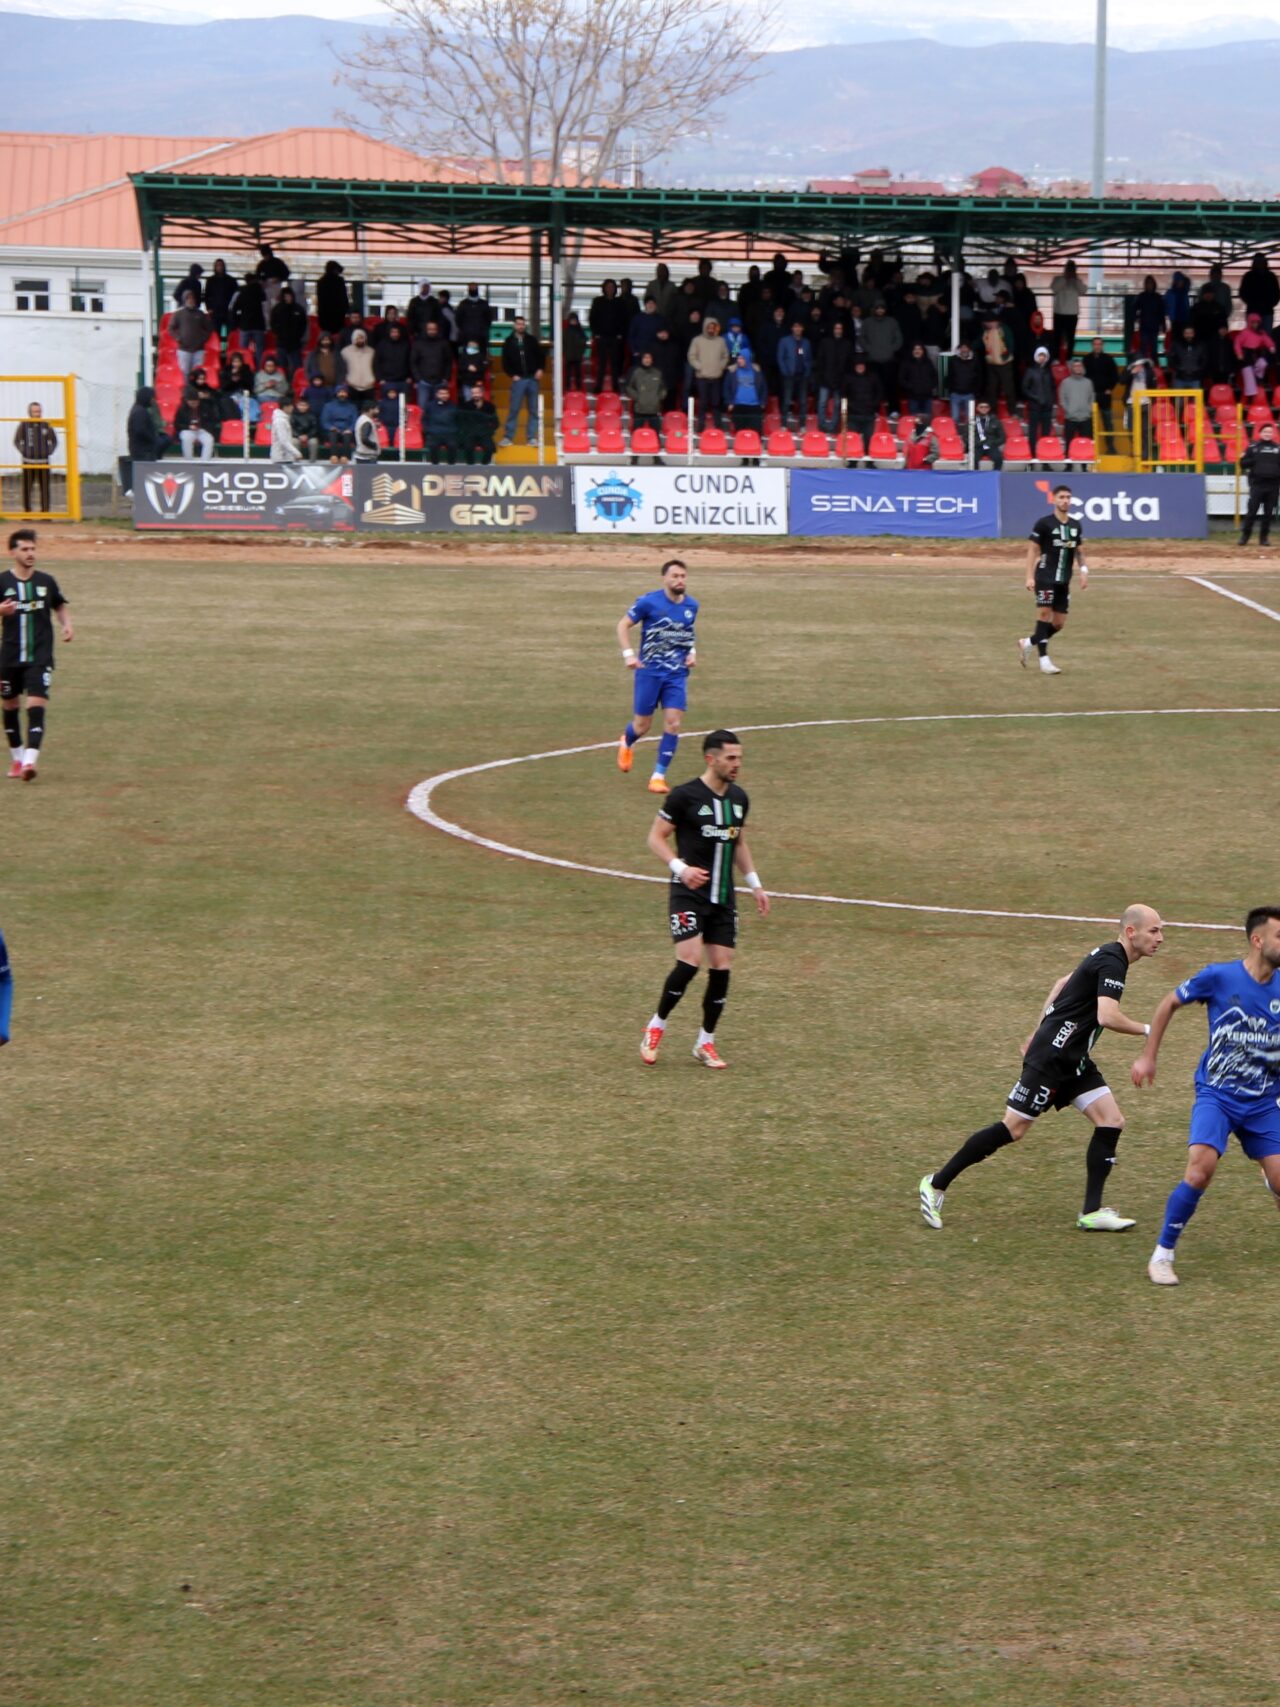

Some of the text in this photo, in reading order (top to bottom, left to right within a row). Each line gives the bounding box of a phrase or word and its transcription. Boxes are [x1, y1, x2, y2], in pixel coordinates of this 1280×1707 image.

[422, 474, 564, 497] DERMAN
[673, 473, 755, 494] CUNDA
[202, 490, 268, 504] OTO
[810, 495, 978, 514] SENATECH
[1067, 491, 1161, 522] cata
[451, 503, 538, 526] GRUP
[653, 502, 778, 526] DENİZCİLİK
[1052, 1020, 1076, 1048] PERA
